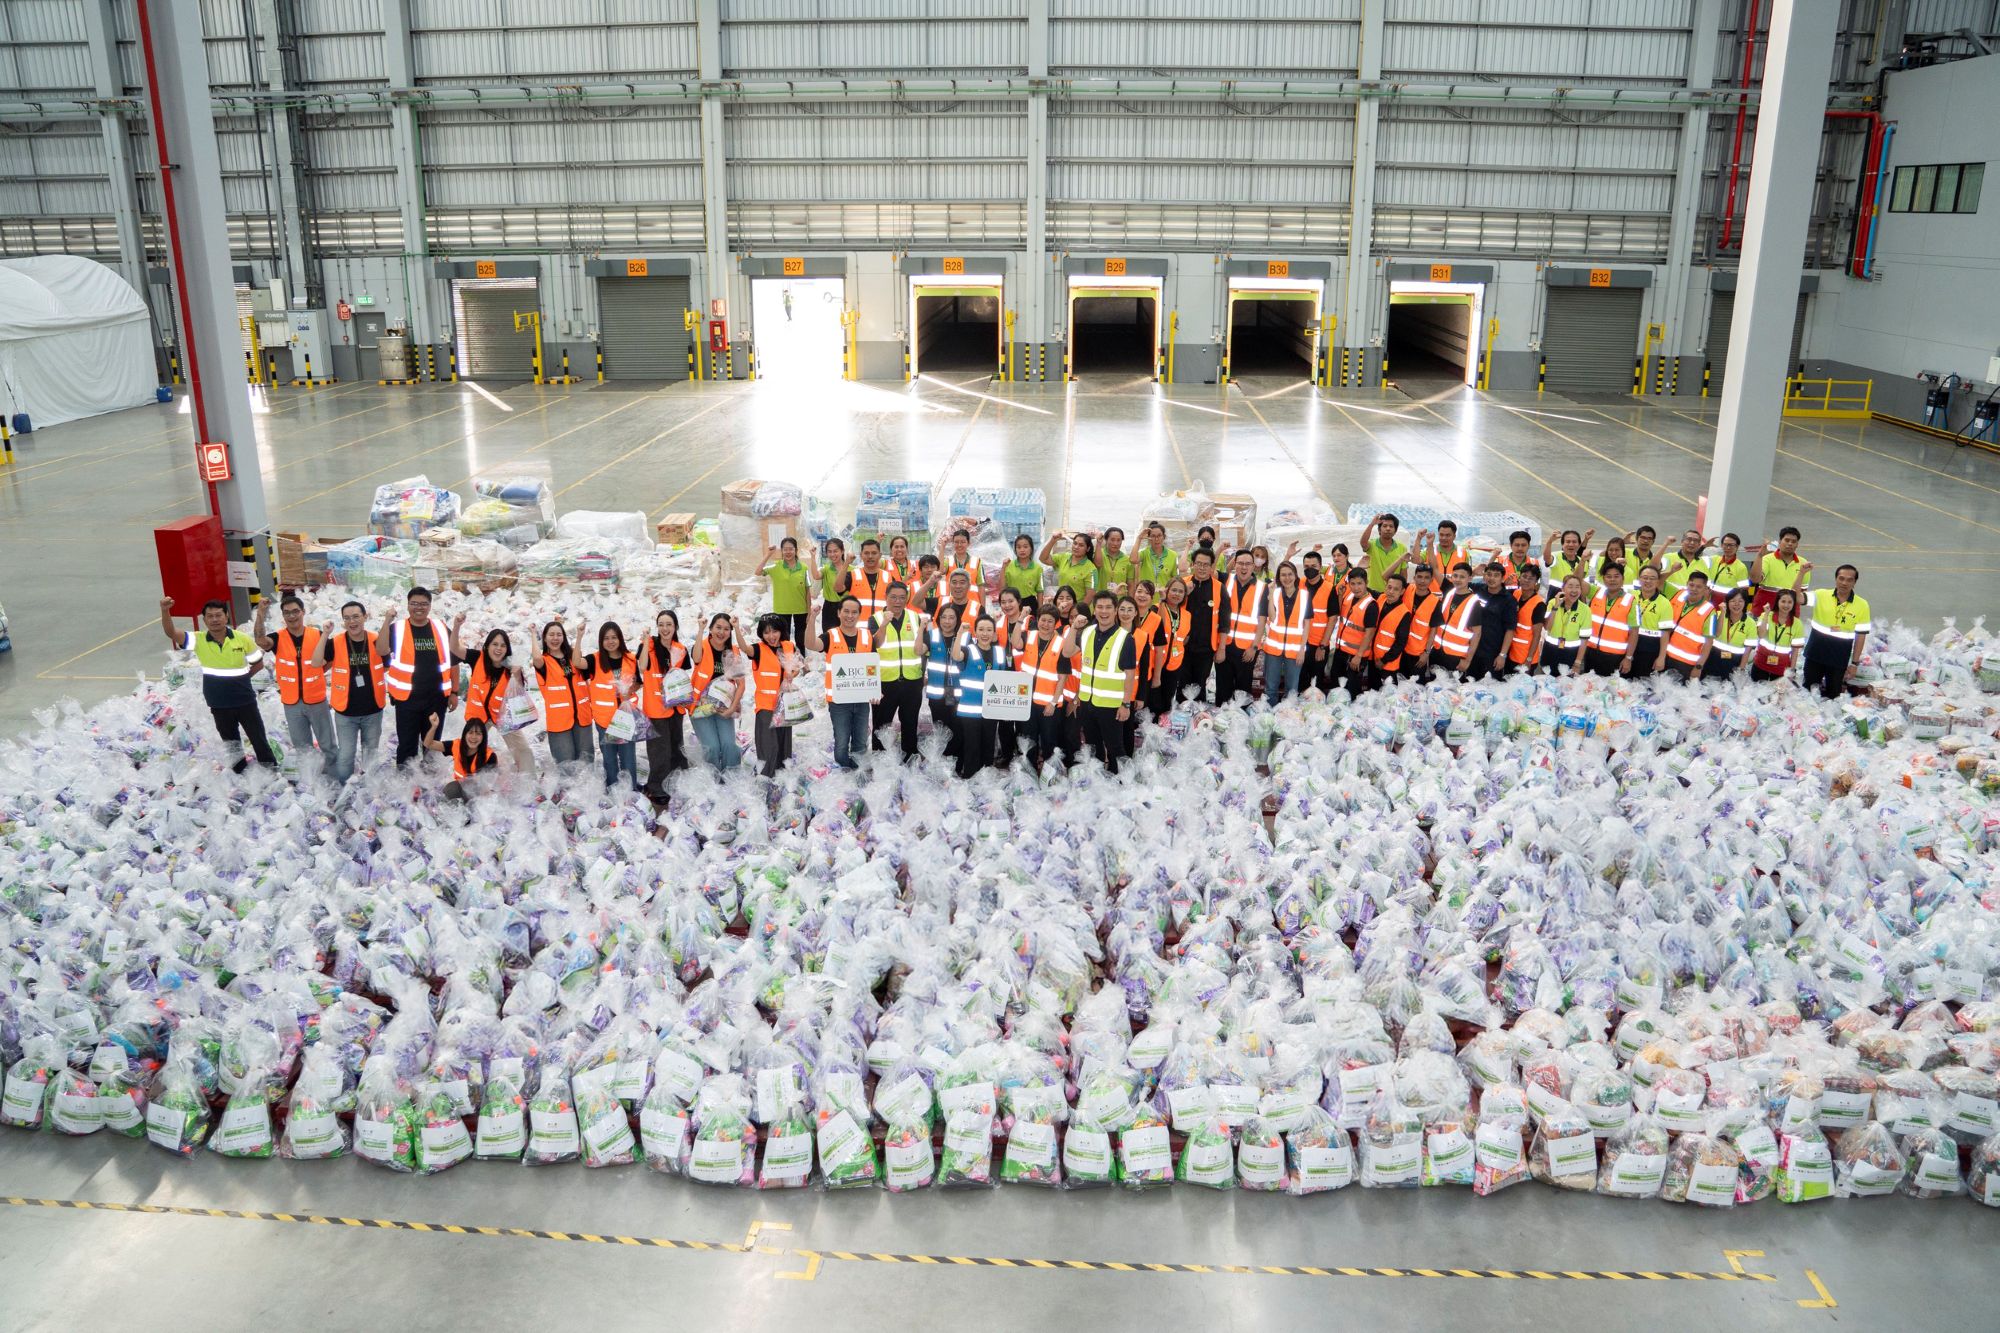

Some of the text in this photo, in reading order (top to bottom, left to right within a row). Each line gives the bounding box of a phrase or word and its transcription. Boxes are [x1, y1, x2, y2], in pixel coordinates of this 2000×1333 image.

[478, 265, 494, 274] B25
[629, 263, 645, 273] B26
[785, 262, 801, 271] B27
[945, 262, 962, 271] B28
[1106, 262, 1124, 272] B29
[1269, 265, 1287, 275] B30
[1432, 268, 1449, 278] B31
[1591, 273, 1609, 283] B32
[848, 668, 864, 677] BJC
[1000, 684, 1016, 695] BJC
